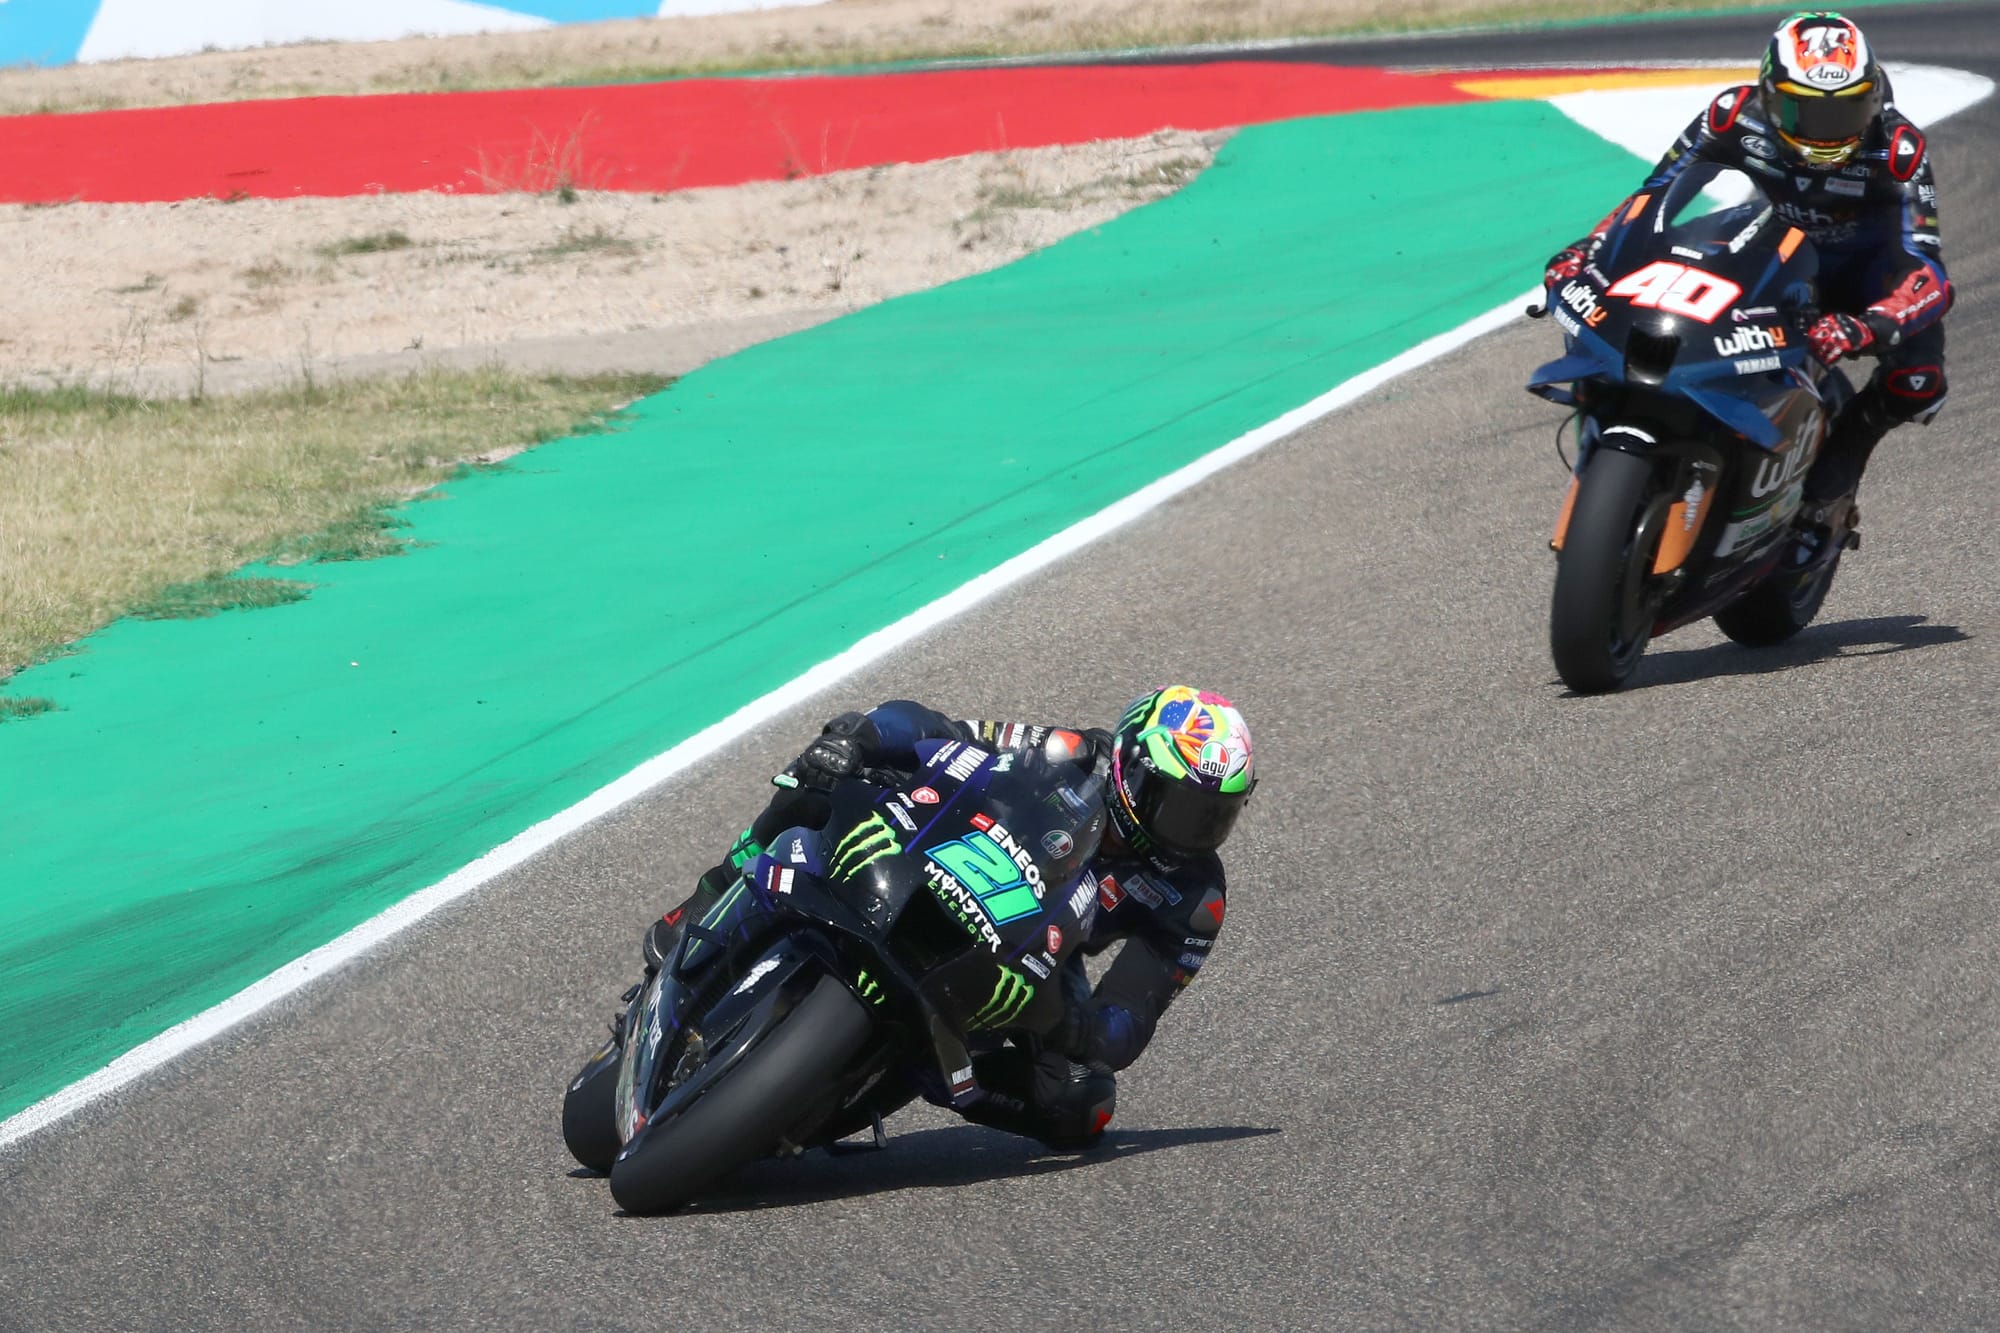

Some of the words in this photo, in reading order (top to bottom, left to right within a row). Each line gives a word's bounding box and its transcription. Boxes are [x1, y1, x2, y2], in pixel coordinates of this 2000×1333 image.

[1808, 65, 1845, 79] Arai
[1606, 260, 1743, 325] 40
[1734, 355, 1781, 375] YAMAHA
[944, 745, 989, 782] YAMAHA
[1202, 759, 1227, 774] agv
[924, 830, 1043, 927] 21
[987, 823, 1047, 900] ENEOS
[924, 861, 1002, 954] MONSTER
[927, 880, 985, 943] ENERGY
[1068, 868, 1099, 919] YAMAHA
